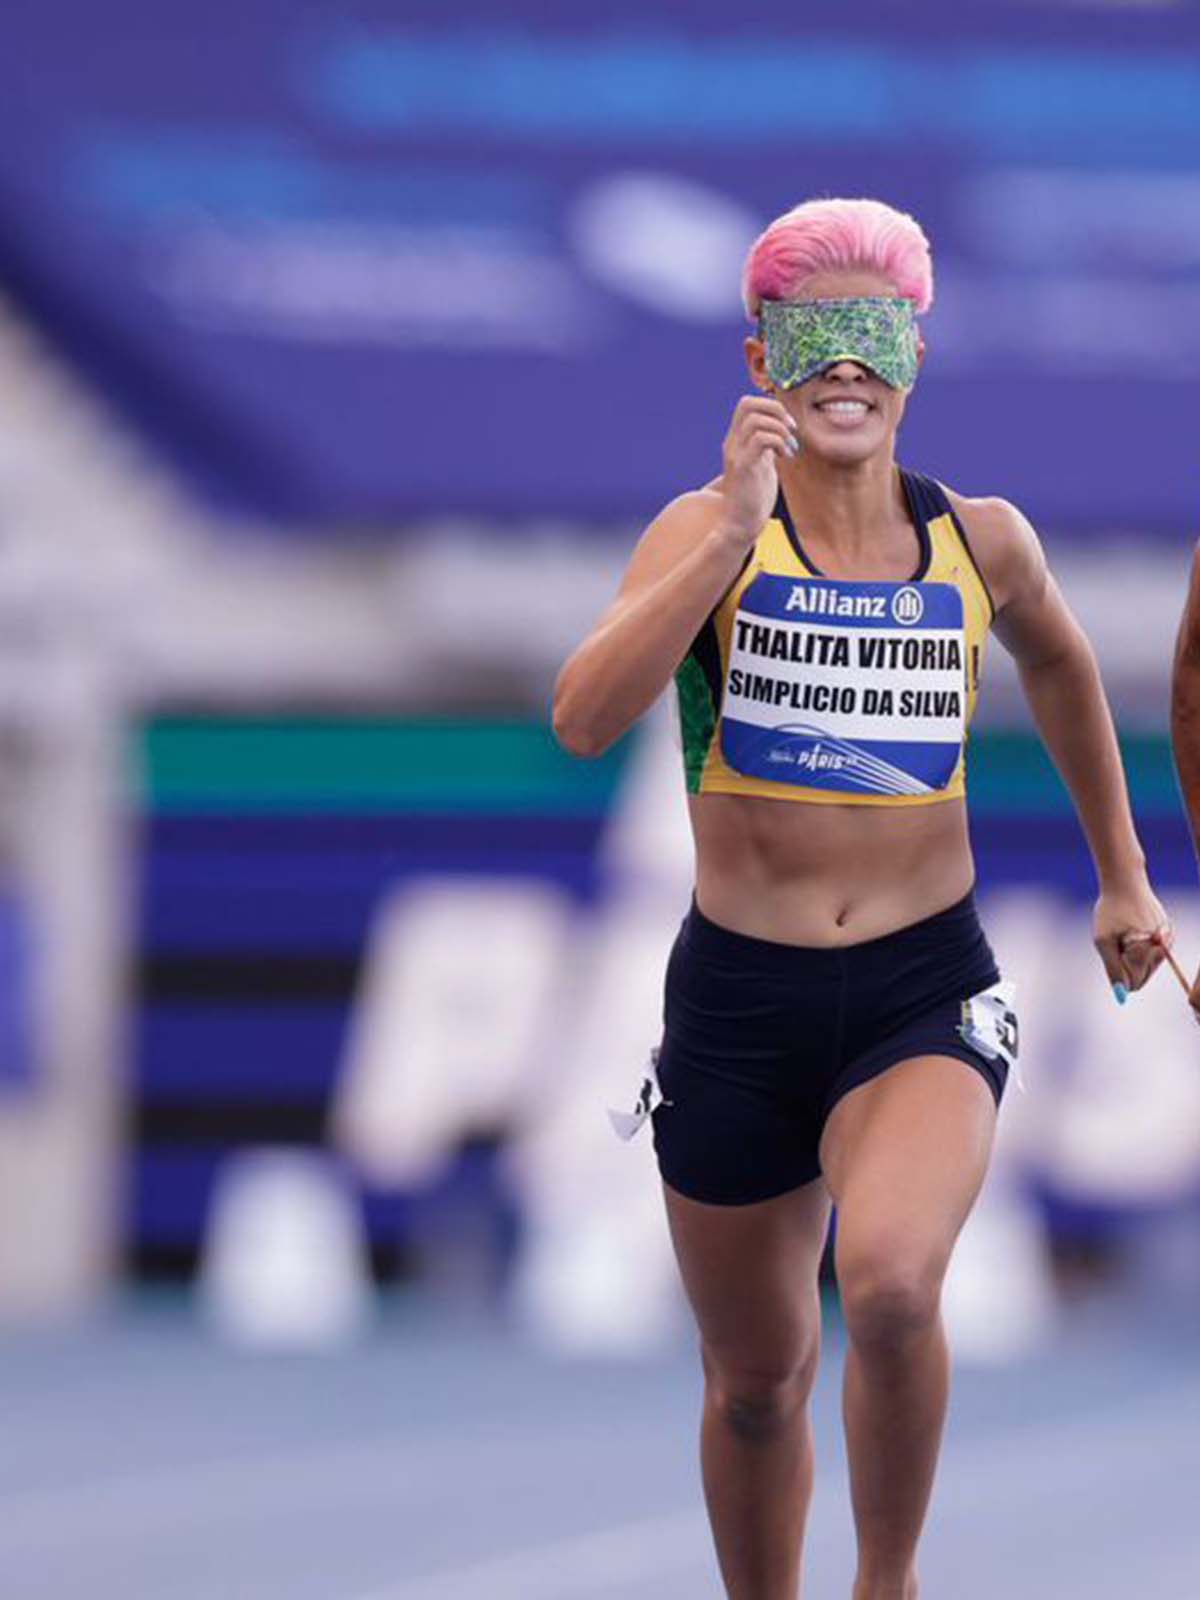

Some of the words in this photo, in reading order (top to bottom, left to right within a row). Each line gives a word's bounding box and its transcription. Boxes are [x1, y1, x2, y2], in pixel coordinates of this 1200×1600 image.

[785, 586, 886, 618] Allianz
[735, 620, 849, 668] THALITA
[858, 637, 961, 671] VITORIA
[728, 668, 857, 715] SIMPLICIO
[862, 688, 894, 717] DA
[899, 690, 961, 718] SILVA
